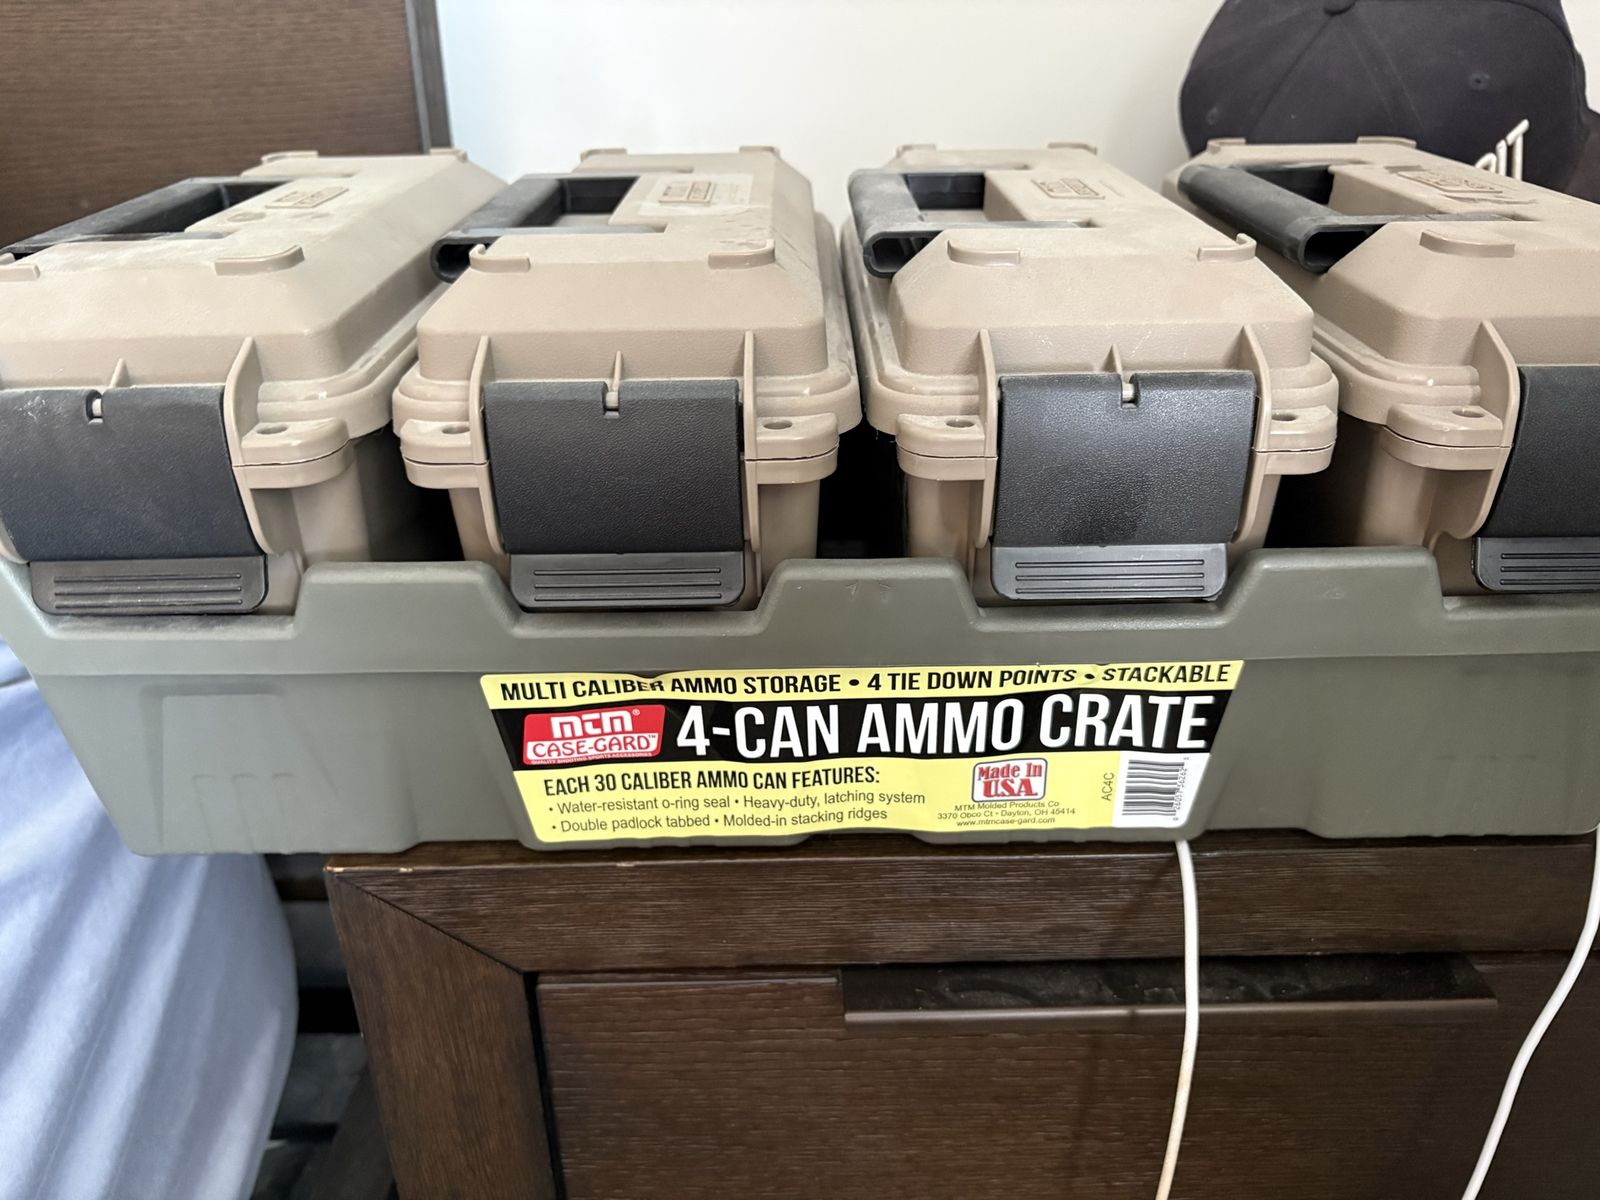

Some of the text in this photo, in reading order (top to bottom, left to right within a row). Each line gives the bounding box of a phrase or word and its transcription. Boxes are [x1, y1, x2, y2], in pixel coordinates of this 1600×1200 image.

[500, 664, 1231, 701] MULTI CALIBER AMMO STORAGE 4 TIE DOWN POINTS STACKABLE
[676, 693, 1216, 759] 4-CAN AMMO CRATE
[544, 766, 881, 796] EACH 30 CALIBER AMMO CAN FEATURES:
[978, 762, 1043, 780] Made In
[1101, 772, 1115, 801] AC4C
[557, 790, 926, 815] Water-resistant o-ring seal Heavy-duty, latching system
[937, 812, 958, 820] 3370
[983, 809, 993, 818] Ct
[1000, 808, 1032, 819] Dayton,
[1034, 808, 1049, 816] OH
[1050, 807, 1076, 816] 45414
[954, 800, 1060, 812] MTM Molded Products Co
[560, 807, 889, 833] Double padlock tabbed Molded-in stacking ridges
[956, 816, 1056, 827] www.mtmcase-gard.com
